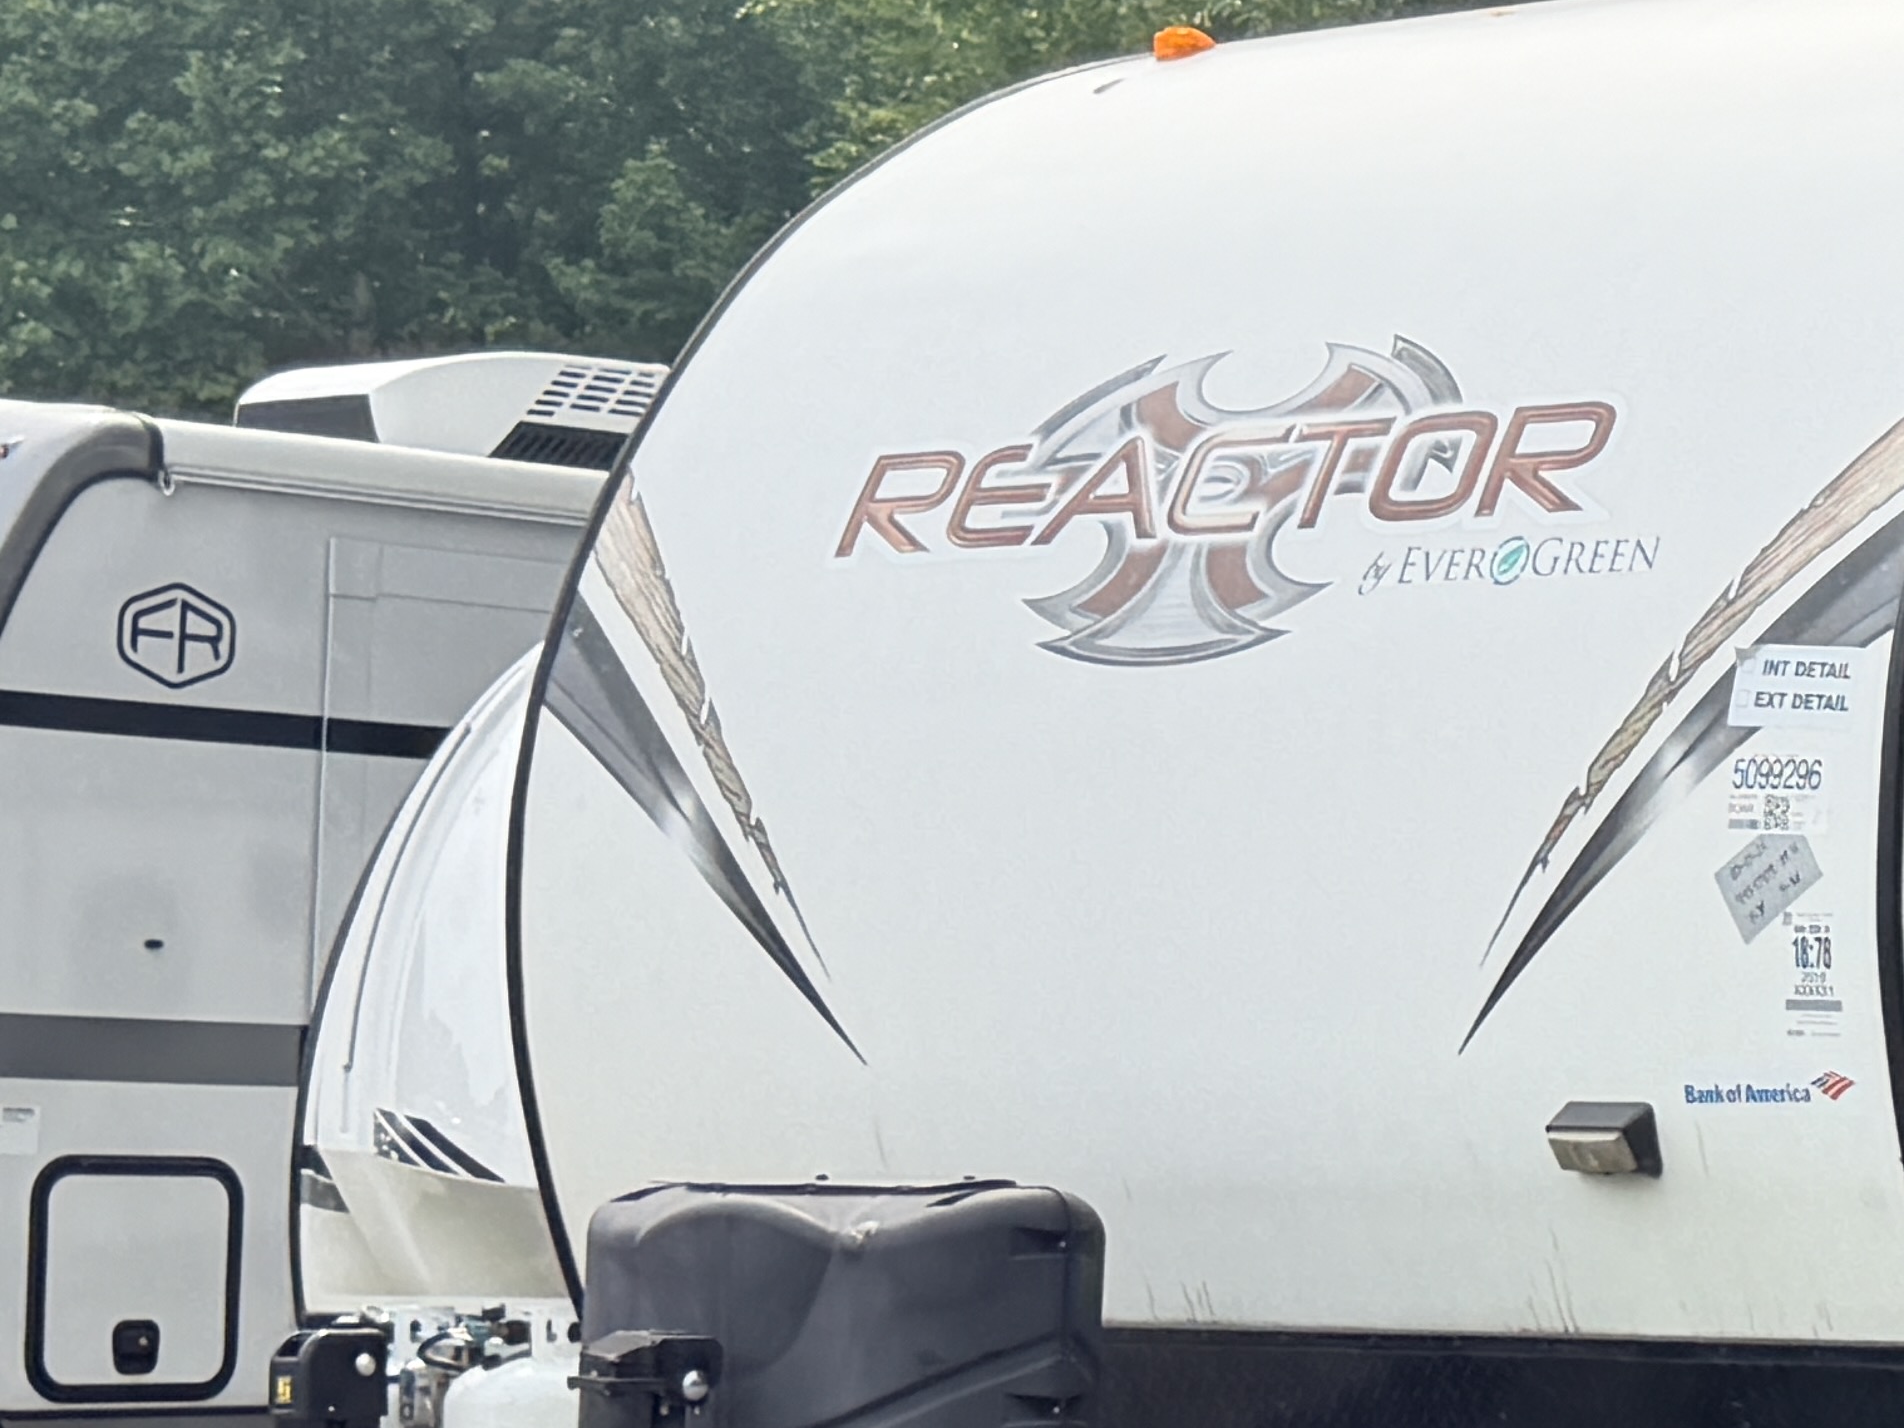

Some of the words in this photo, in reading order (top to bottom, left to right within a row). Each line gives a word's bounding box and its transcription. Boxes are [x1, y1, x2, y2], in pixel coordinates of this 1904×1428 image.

[835, 401, 1617, 558] REACTOR
[1762, 659, 1790, 677] INT
[1794, 661, 1850, 679] DETAIL
[1754, 691, 1788, 709] EXT
[1791, 693, 1848, 711] DETAIL
[1732, 758, 1822, 790] 5099296
[1684, 1084, 1724, 1104] Bank
[1726, 1083, 1742, 1103] of
[1746, 1082, 1811, 1103] America
